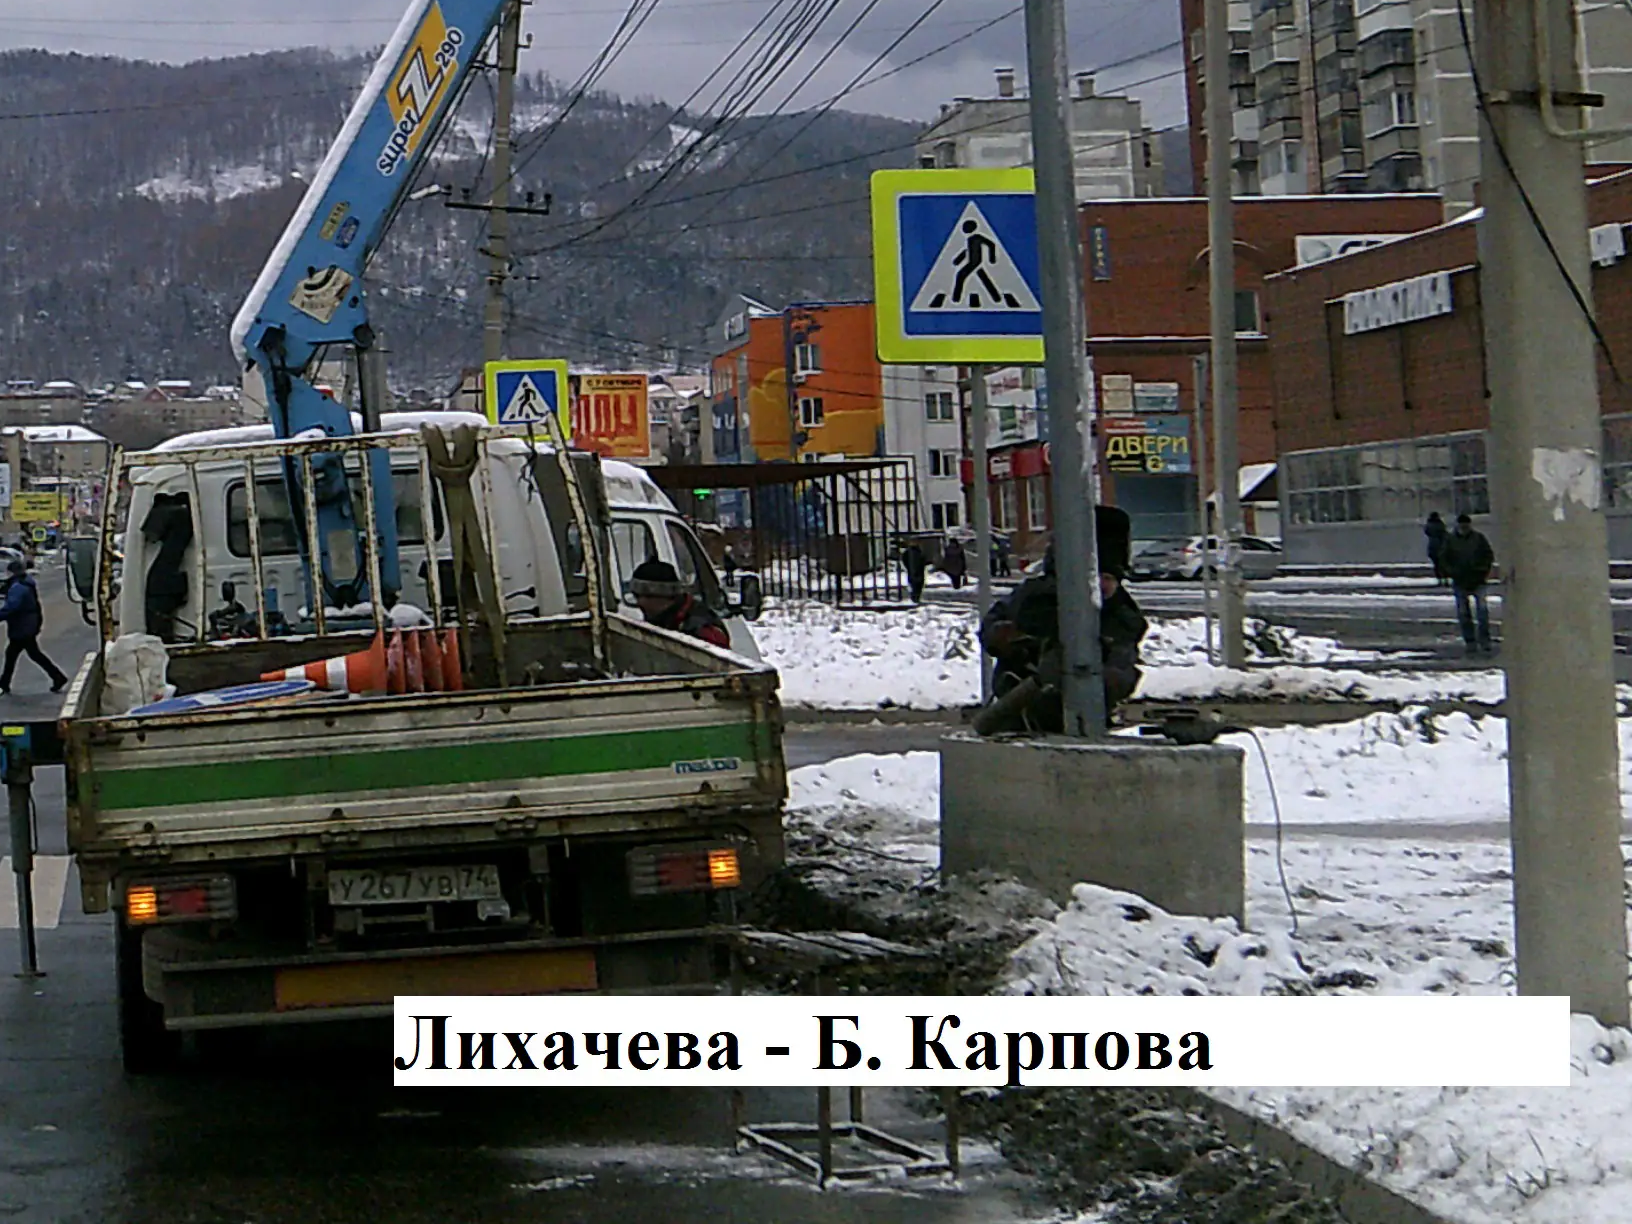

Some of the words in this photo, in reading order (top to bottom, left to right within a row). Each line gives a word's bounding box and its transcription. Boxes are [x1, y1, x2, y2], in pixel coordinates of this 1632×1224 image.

[378, 108, 419, 175] super
[434, 28, 463, 68] 290
[1106, 436, 1188, 459] ДВЕРИ
